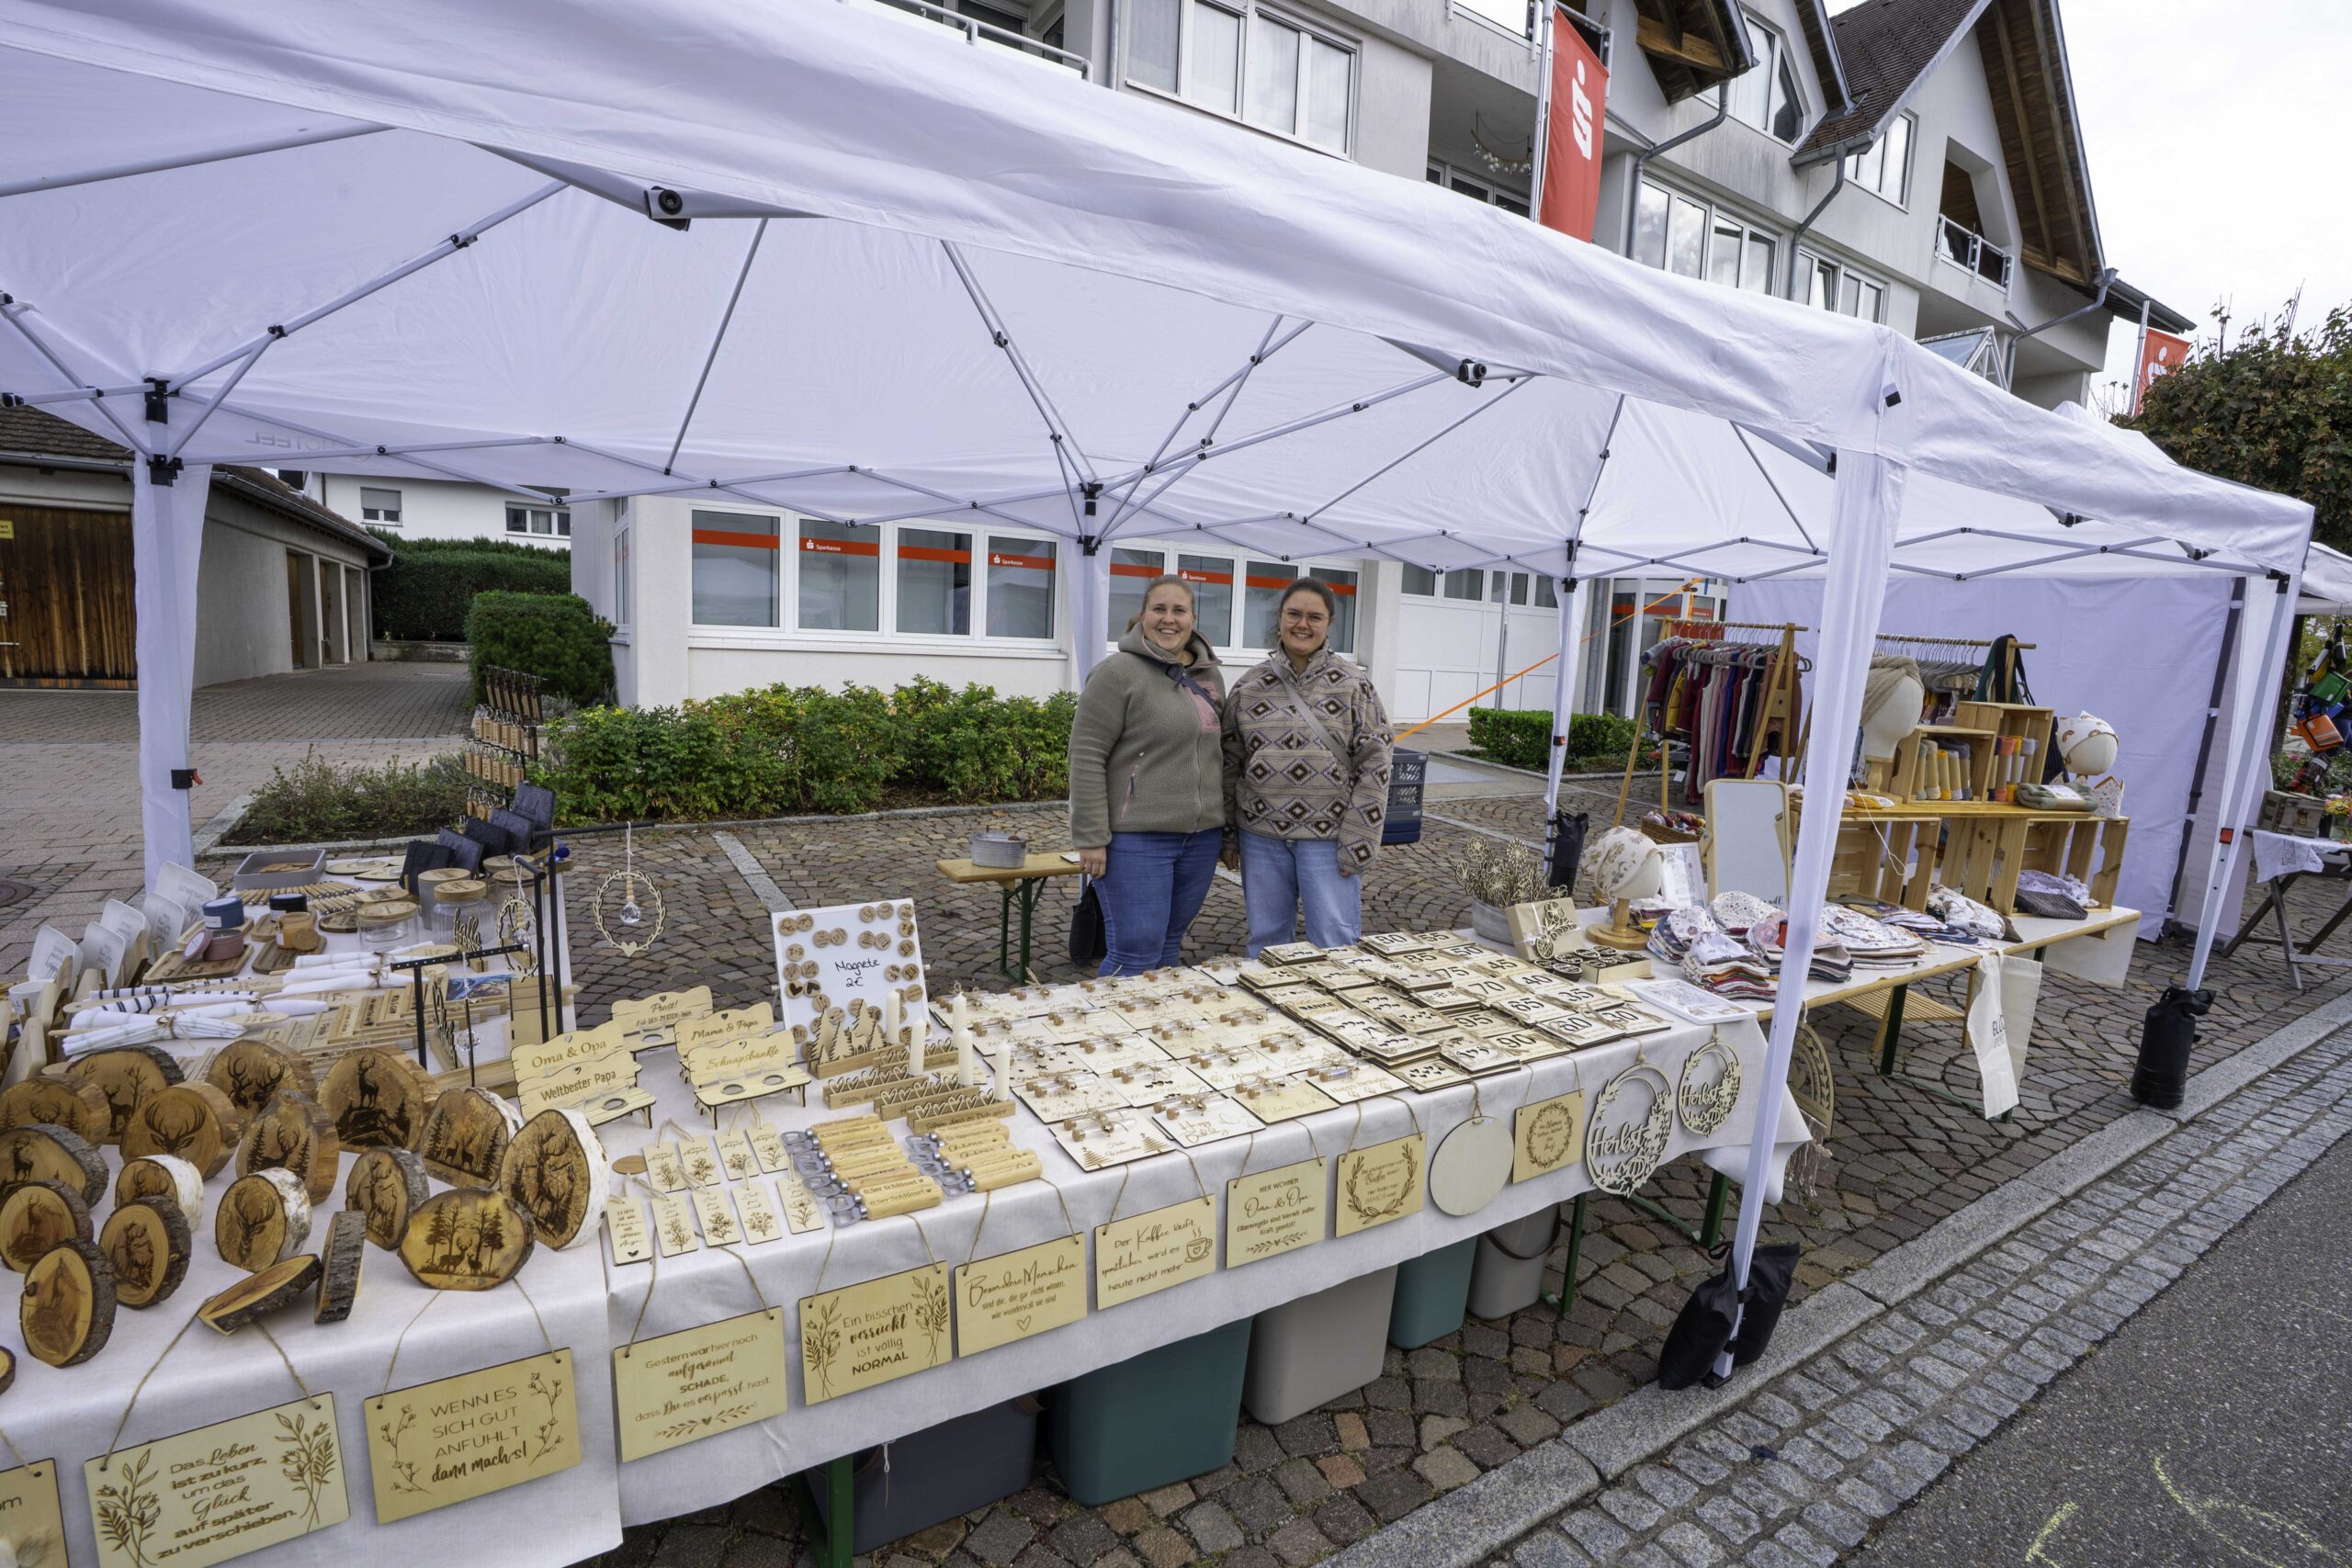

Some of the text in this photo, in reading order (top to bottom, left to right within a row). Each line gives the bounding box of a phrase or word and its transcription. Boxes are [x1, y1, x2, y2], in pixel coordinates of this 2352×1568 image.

[816, 543, 842, 553] Sparkasse
[1001, 558, 1023, 567] Sparkasse
[1419, 931, 1450, 942] 55
[1451, 945, 1485, 957] 50
[834, 958, 880, 976] Magnete
[1434, 965, 1470, 979] 75
[1487, 958, 1519, 970] 45
[845, 976, 865, 988] 2€
[1468, 980, 1507, 996] 70
[1521, 975, 1554, 987] 40
[1507, 997, 1545, 1012] 65
[1558, 987, 1595, 1001] 35
[650, 998, 679, 1014] Prost!
[1602, 1010, 1639, 1023] 30
[691, 1021, 761, 1042] Mama & Papa
[1453, 1013, 1494, 1029] 95
[1561, 1017, 1593, 1032] 60
[1496, 1033, 1536, 1049] 90
[531, 1039, 607, 1069] Oma & Opa
[706, 1045, 781, 1071] Schnapsbänkle
[540, 1068, 617, 1102] Weltbester Papa
[1680, 1081, 1724, 1108] Herbst
[950, 1116, 967, 1126] dass
[977, 1111, 992, 1121] Dich
[1590, 1121, 1648, 1159] Herbst
[883, 1179, 918, 1190] Schlüssel
[889, 1188, 926, 1201] Schlüssel
[1259, 1178, 1299, 1193] HIER WOHNEN
[1244, 1186, 1310, 1218] Oma & Opa
[1237, 1219, 1269, 1233] Elternregeln
[1270, 1214, 1282, 1224] sind
[1282, 1210, 1301, 1220] hiermit
[1260, 1221, 1296, 1235] Kraft gesetzt!
[1114, 1236, 1132, 1249] Der
[1136, 1223, 1170, 1251] Kaffee
[1102, 1246, 1181, 1279] sportlicher wird es
[964, 1254, 1079, 1308] Besondere Menschen
[1108, 1278, 1134, 1292] heute
[1136, 1269, 1158, 1284] nicht
[982, 1300, 995, 1311] sind
[1009, 1293, 1018, 1303] die
[1019, 1291, 1029, 1302] gar
[1030, 1286, 1046, 1298] nicht
[991, 1294, 1057, 1321] wie wundervoll sie sind
[842, 1302, 913, 1329] Ein bisschen
[850, 1313, 908, 1345] verrückt
[645, 1333, 759, 1371] Gestern war hier noch
[856, 1337, 904, 1359] ist völlig
[852, 1351, 910, 1376] NORMAL
[430, 1385, 518, 1418] WENN ES
[634, 1376, 773, 1423] dass Du es verpasst hast.
[432, 1405, 519, 1440] SICH GUT
[434, 1425, 522, 1461] ANFÜHLT
[170, 1442, 259, 1475] Das Leben
[171, 1457, 268, 1491] ist zu kurz,
[431, 1462, 469, 1483] dann
[181, 1473, 246, 1501] um das
[192, 1484, 252, 1521] Glück
[174, 1500, 275, 1540] auf später
[157, 1509, 298, 1561] zu verschieben.
